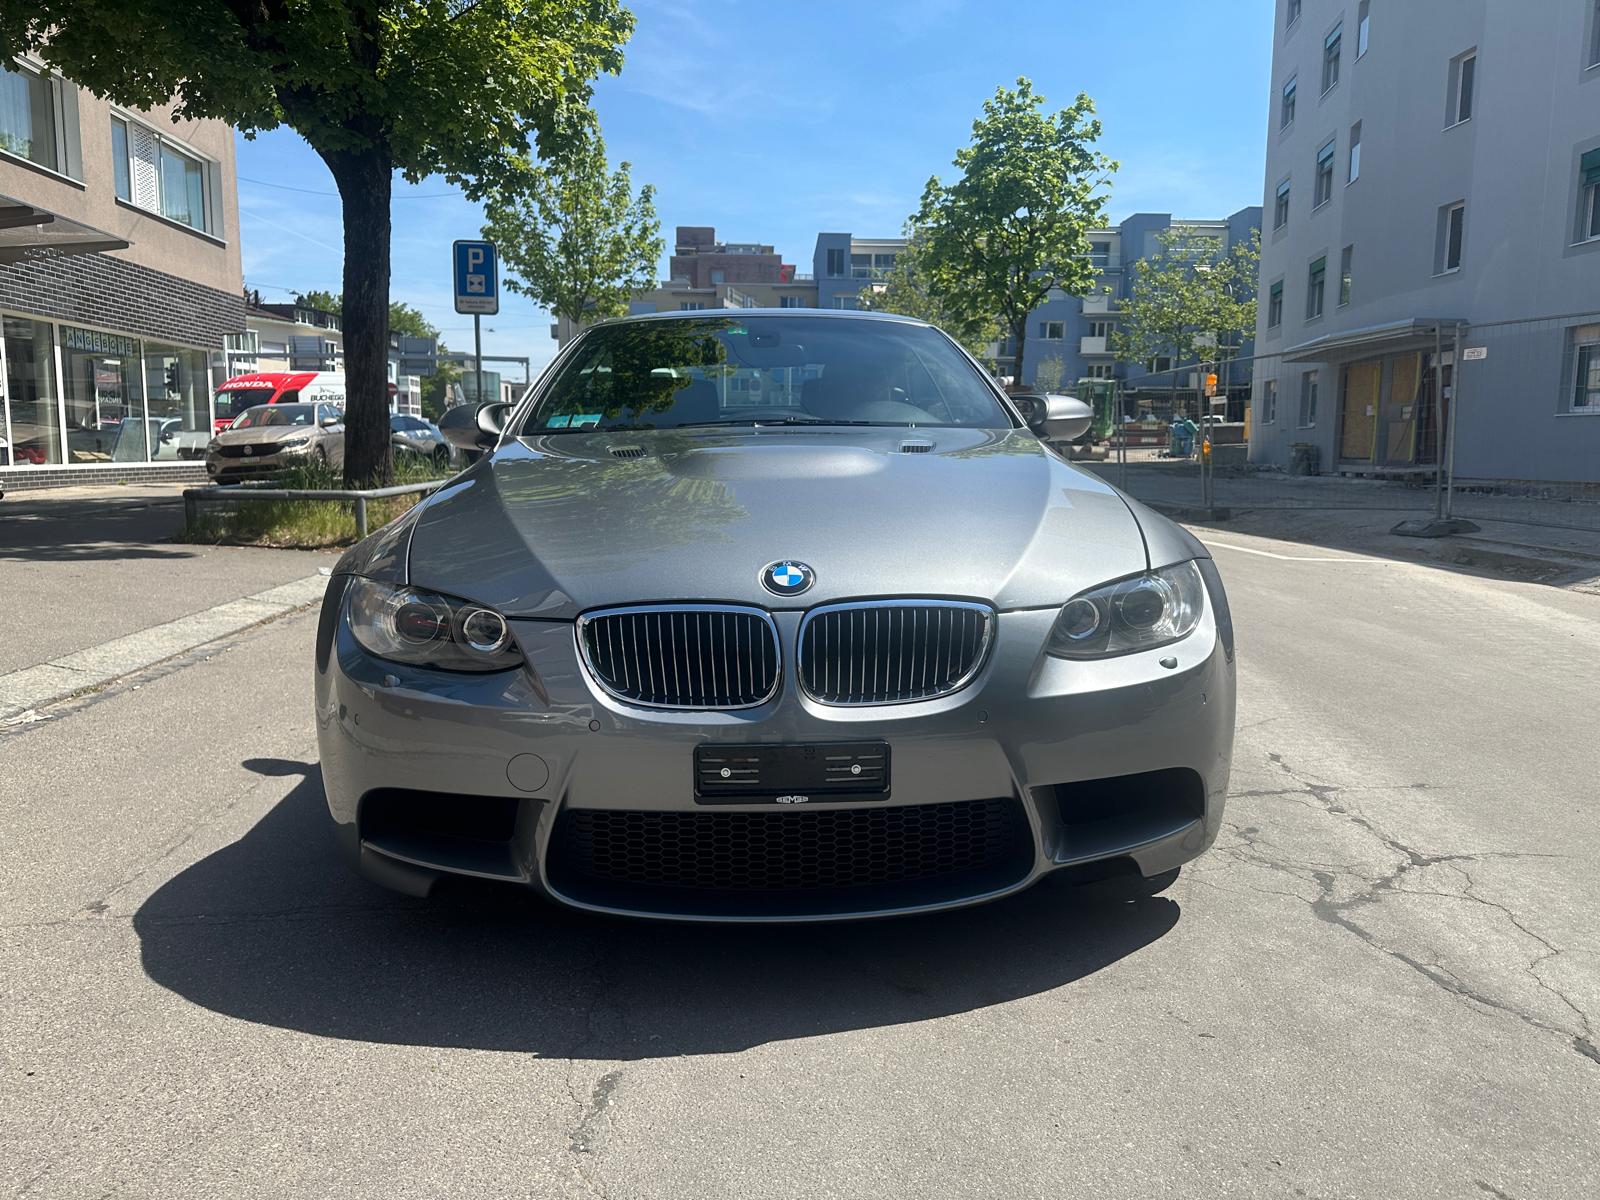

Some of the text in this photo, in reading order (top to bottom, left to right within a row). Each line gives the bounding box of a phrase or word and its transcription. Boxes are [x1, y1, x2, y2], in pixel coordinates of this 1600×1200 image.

[468, 248, 484, 273] P
[67, 332, 132, 353] ANGEBOTE
[770, 561, 809, 572] BMW
